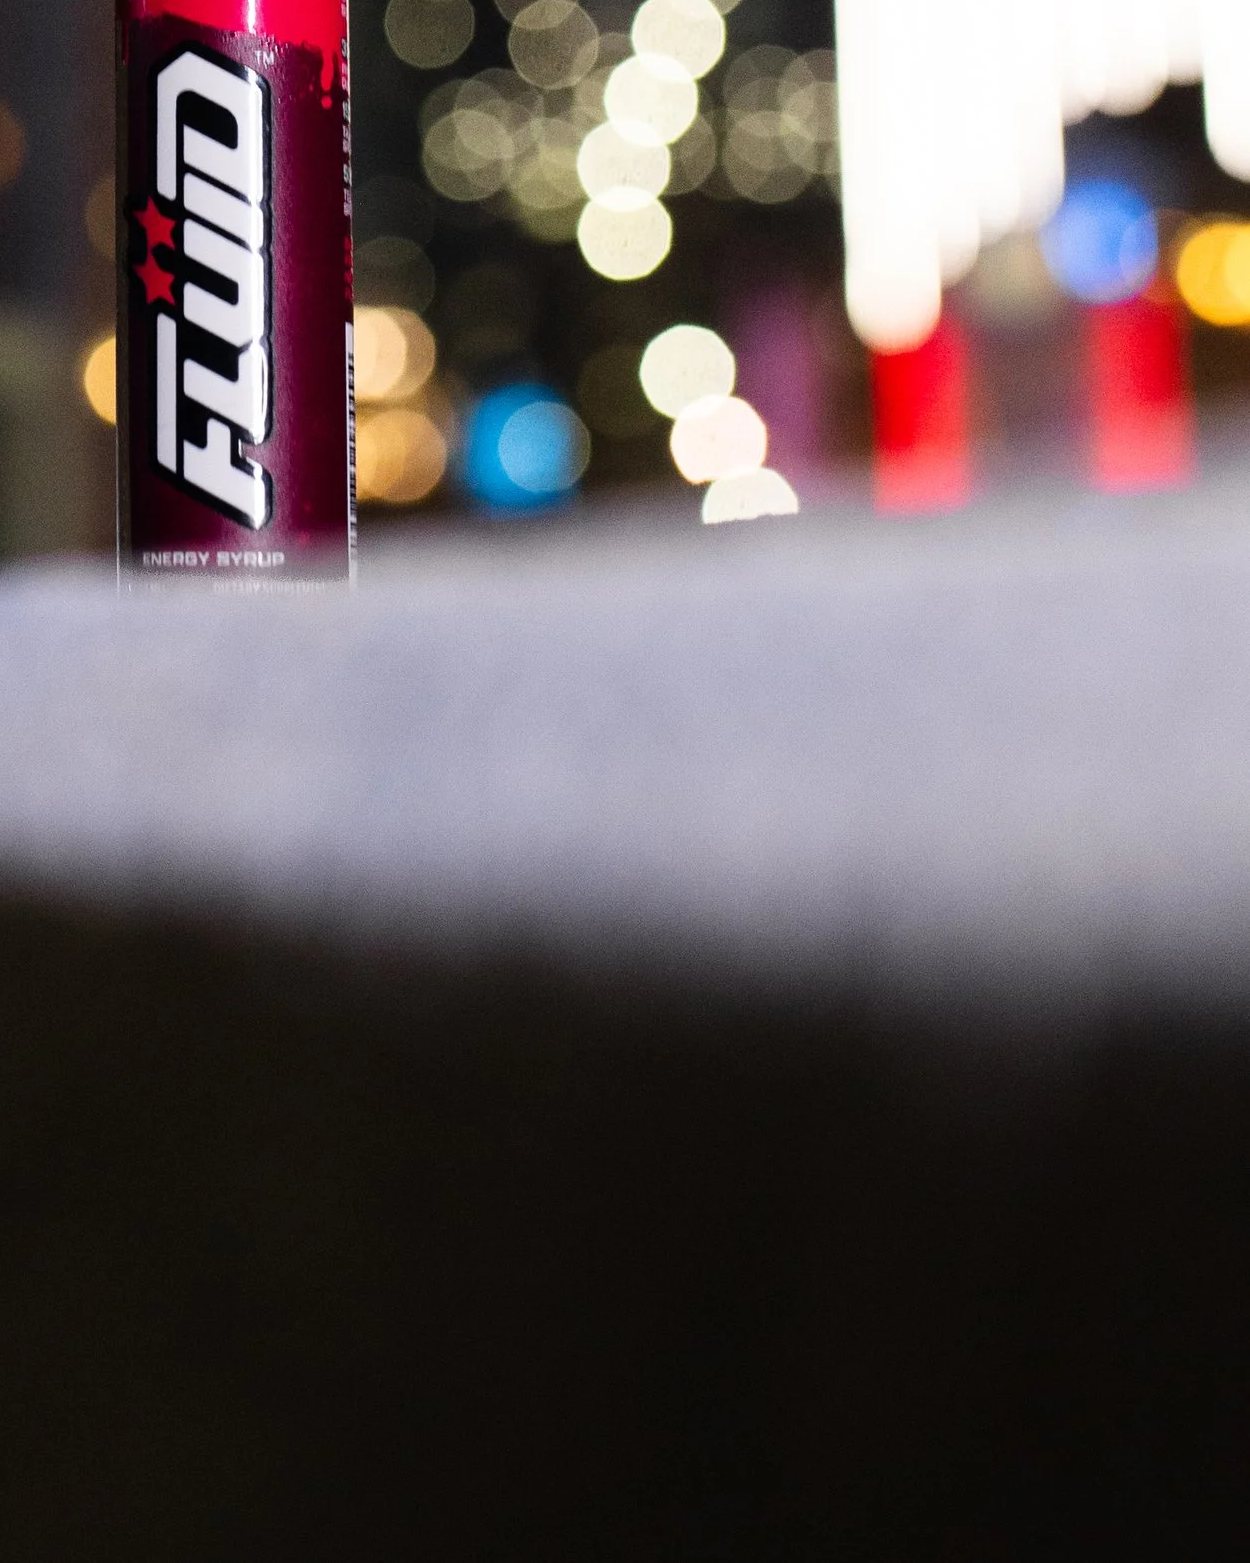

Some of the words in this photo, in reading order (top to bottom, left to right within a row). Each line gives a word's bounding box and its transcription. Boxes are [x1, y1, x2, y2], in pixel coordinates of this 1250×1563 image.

[155, 50, 266, 531] FLUID
[143, 550, 210, 567] ENERGY
[216, 550, 285, 568] SYRUP
